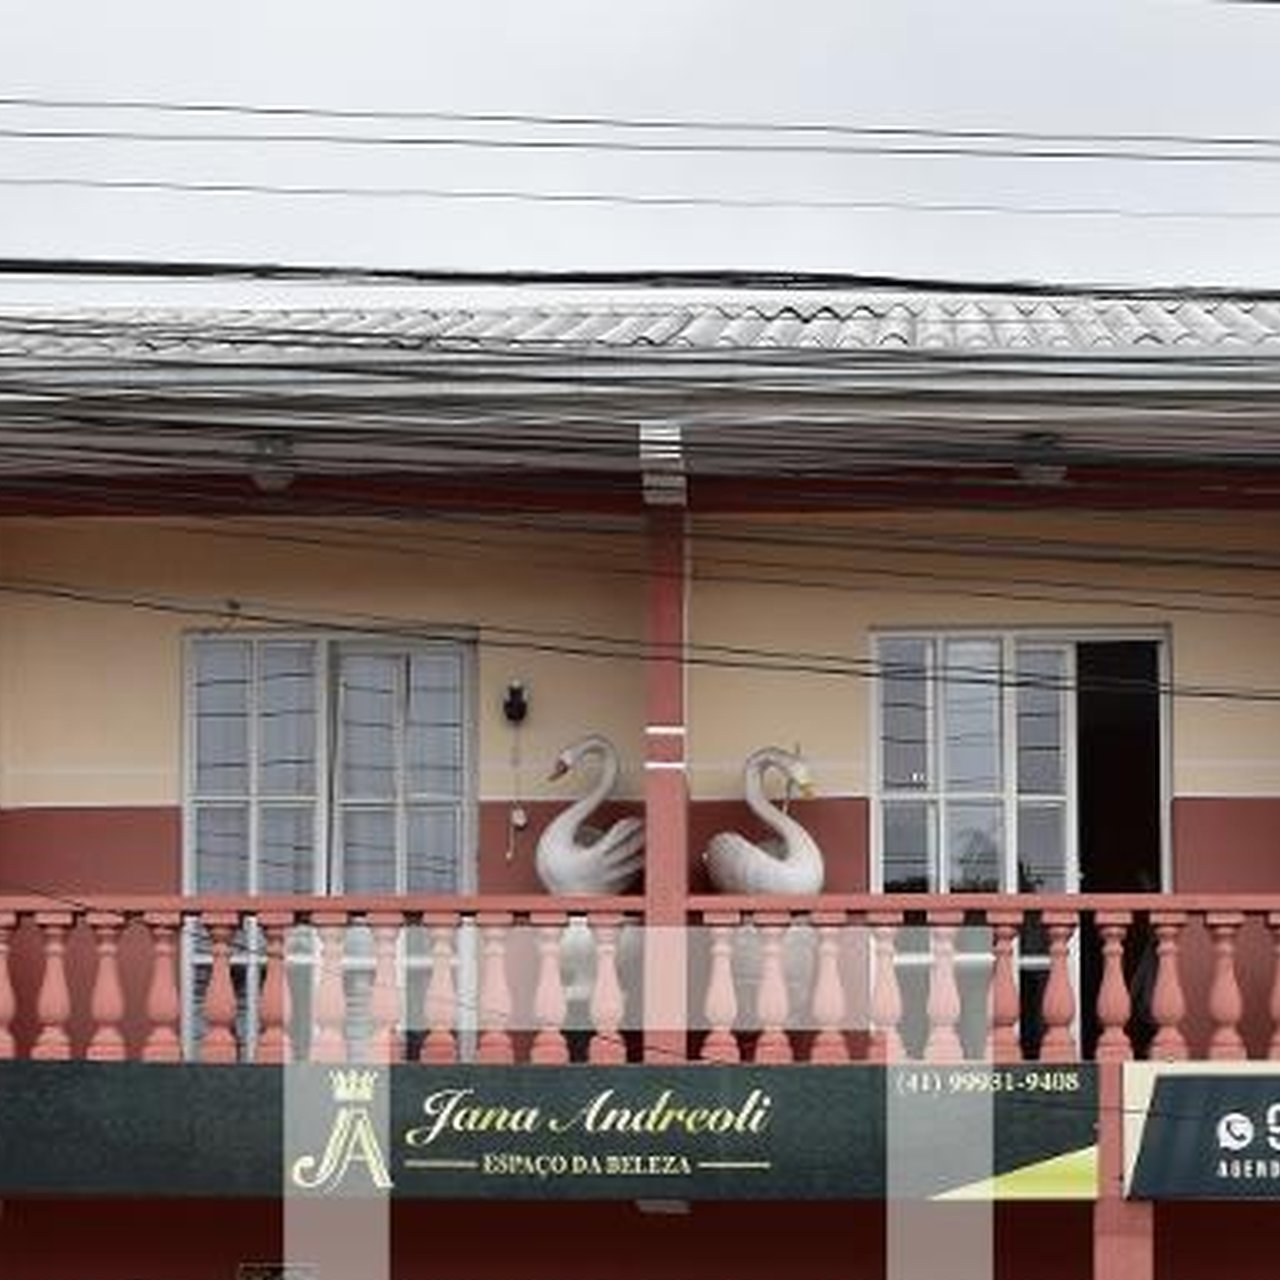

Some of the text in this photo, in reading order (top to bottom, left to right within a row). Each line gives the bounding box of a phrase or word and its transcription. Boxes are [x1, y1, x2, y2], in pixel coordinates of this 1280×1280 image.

[895, 1072, 941, 1096] (41)
[405, 1089, 771, 1146] Jana Andreoli
[482, 1155, 692, 1179] ESPAÇO DA BELEZA
